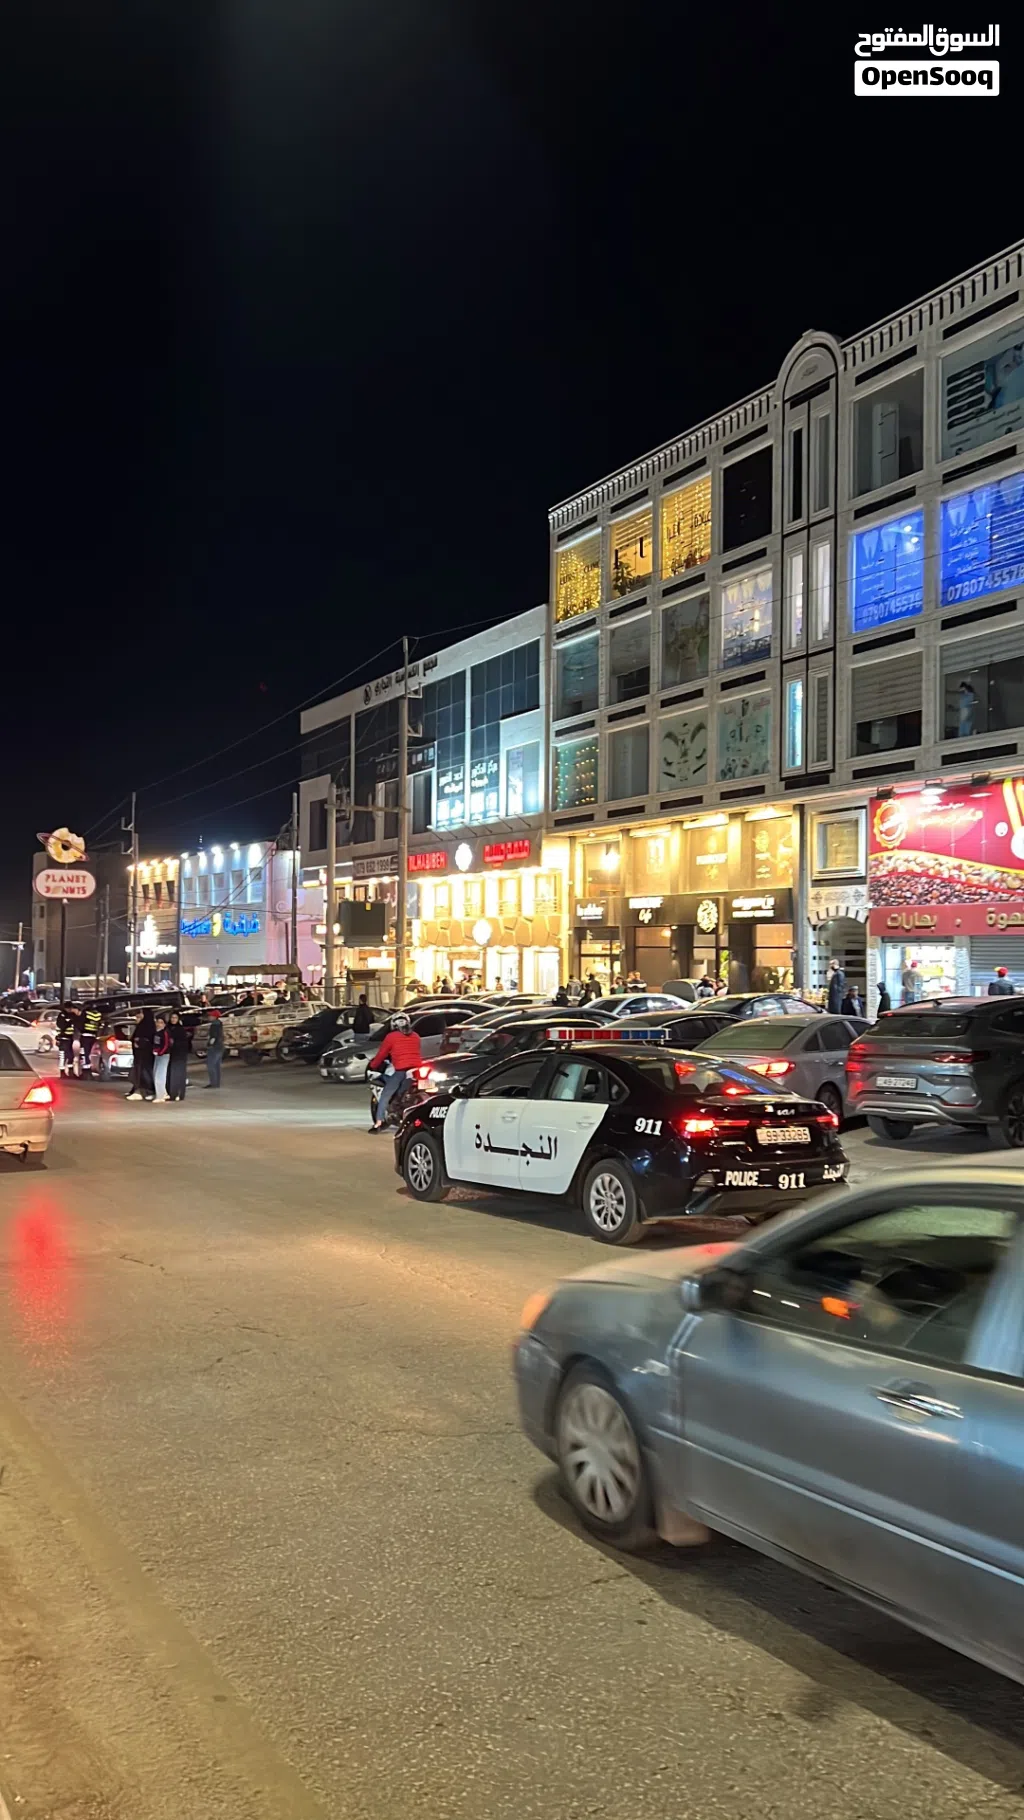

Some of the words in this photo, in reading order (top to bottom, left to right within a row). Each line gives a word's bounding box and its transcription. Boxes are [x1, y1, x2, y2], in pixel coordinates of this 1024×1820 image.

[45, 874, 87, 883] PLANET
[985, 907, 1024, 931] هوة
[429, 1106, 448, 1118] POLICE
[634, 1117, 663, 1136] 911
[475, 1123, 558, 1167] النجدة
[725, 1171, 759, 1187] POLICE
[778, 1172, 806, 1190] 911
